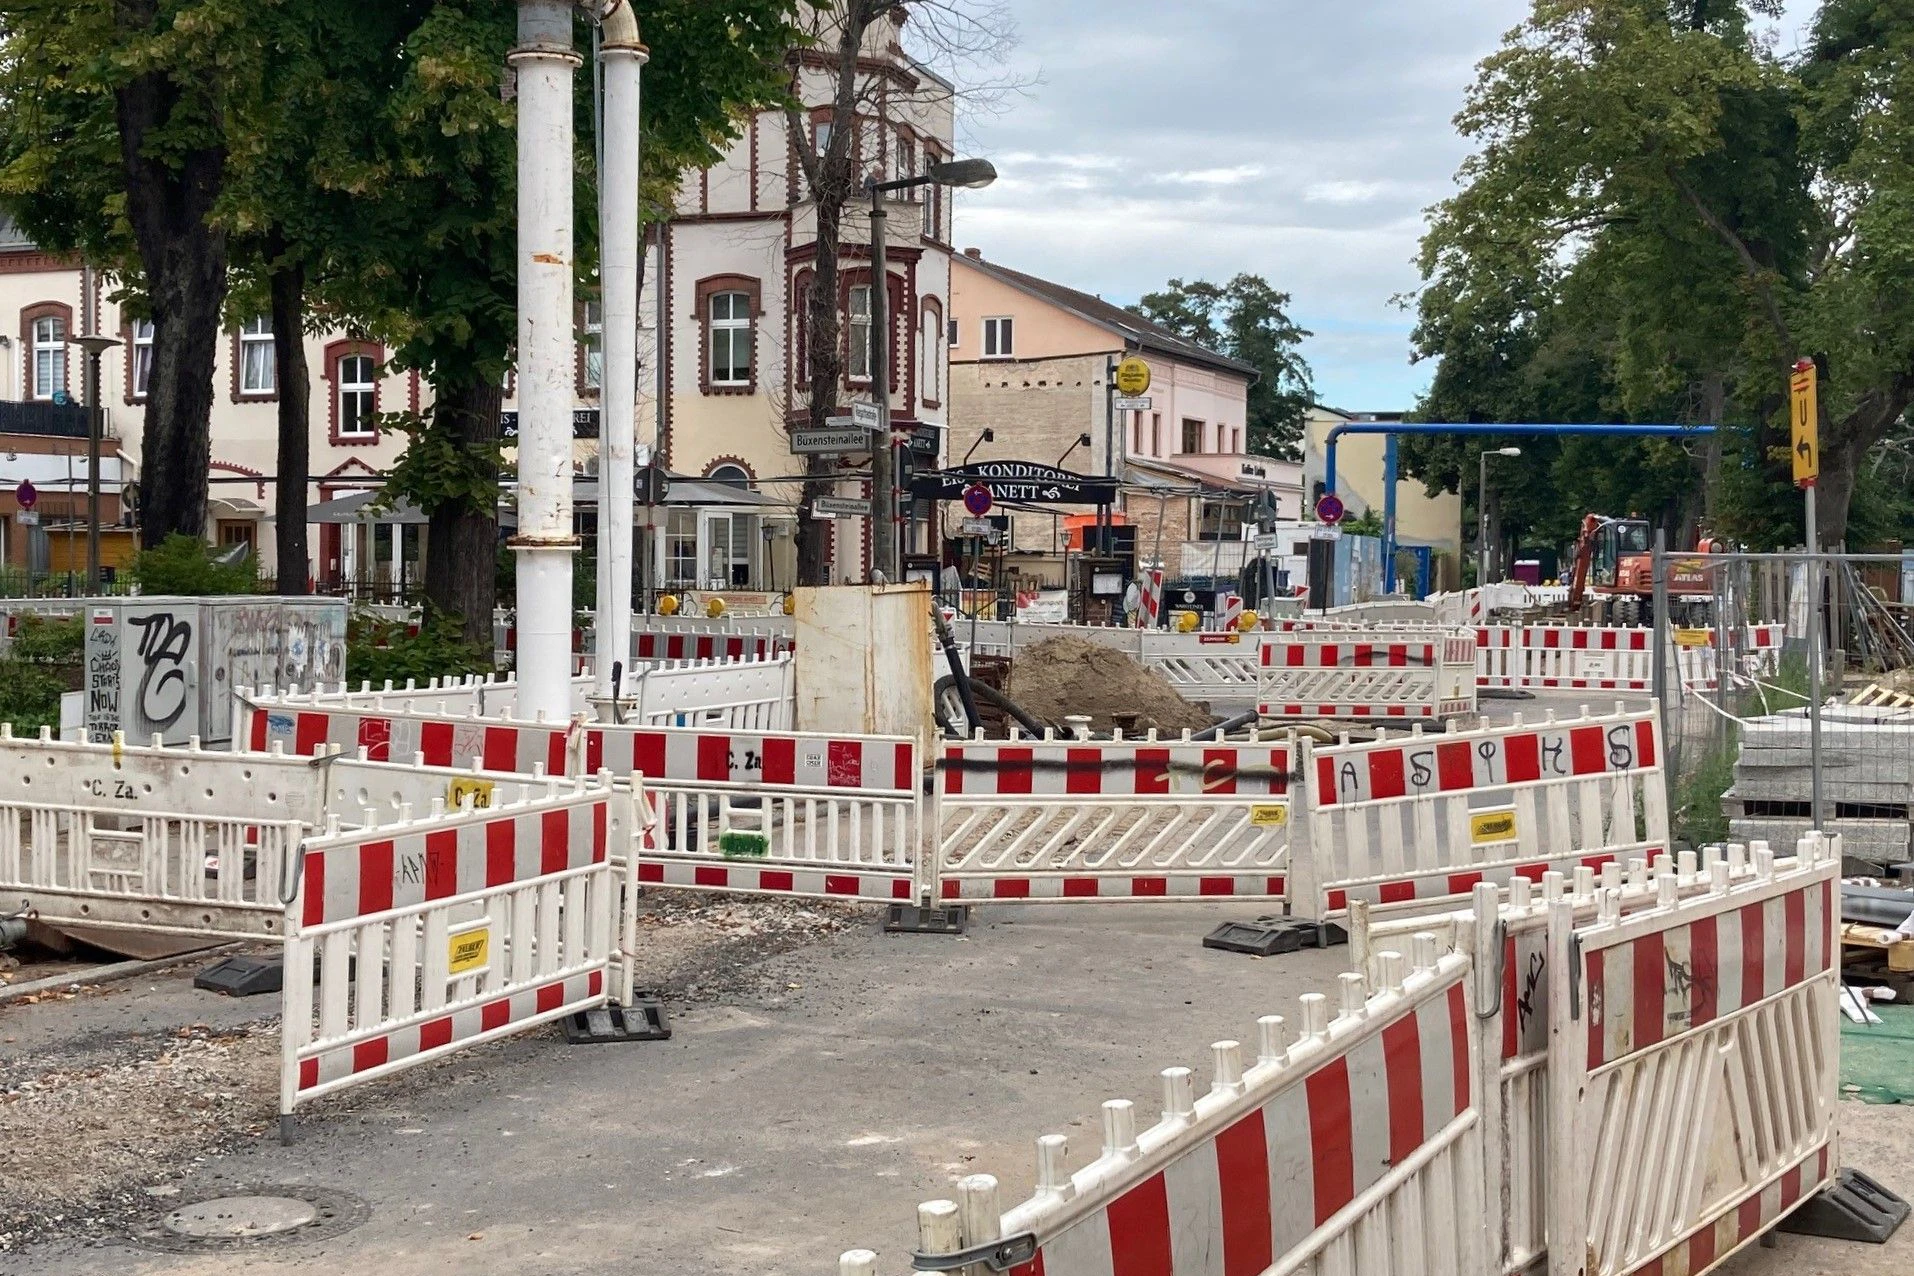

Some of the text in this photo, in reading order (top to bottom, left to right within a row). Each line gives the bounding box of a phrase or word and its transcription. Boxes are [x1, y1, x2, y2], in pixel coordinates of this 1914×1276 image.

[796, 433, 864, 446] Büxensteinallee
[988, 484, 1040, 499] ANETT
[1673, 573, 1704, 582] ATLAS
[91, 690, 118, 712] NOW
[92, 779, 138, 800] C. Za.
